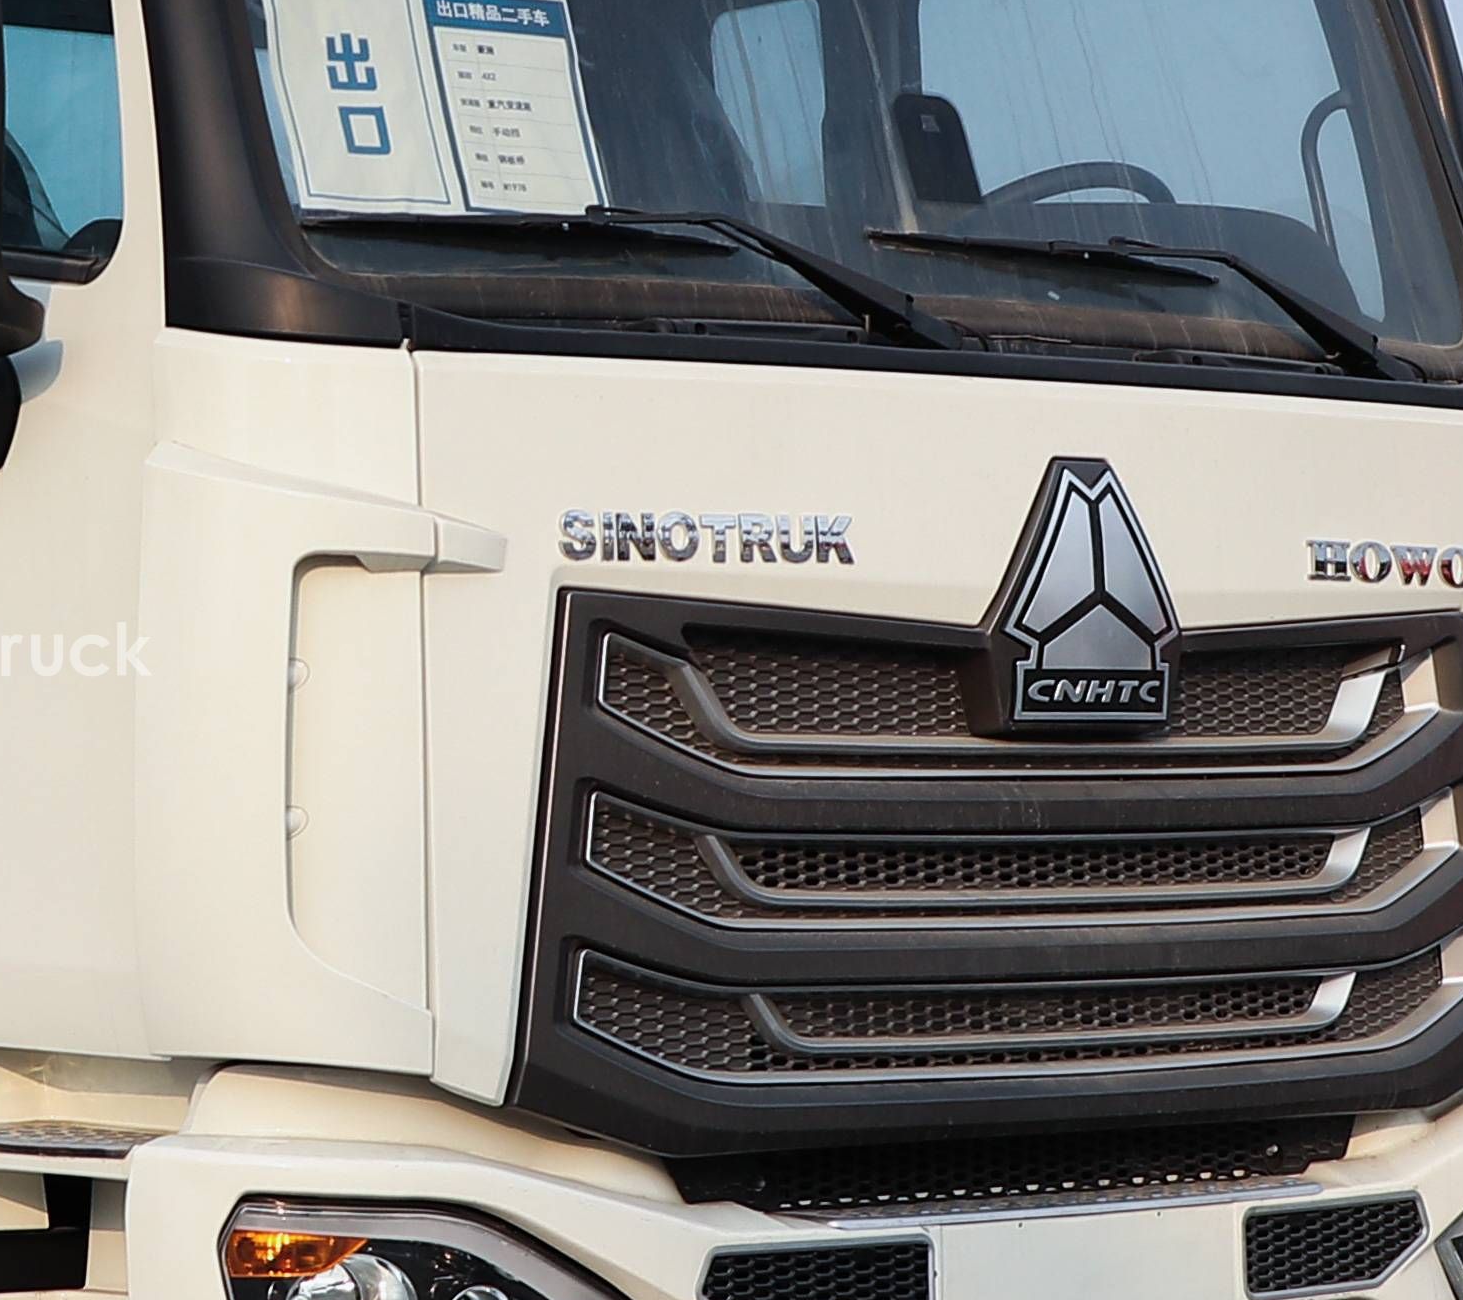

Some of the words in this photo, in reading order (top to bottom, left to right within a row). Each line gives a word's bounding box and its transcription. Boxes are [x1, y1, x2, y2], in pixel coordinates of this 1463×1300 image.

[436, 0, 550, 27] 出口精品二手车
[326, 33, 392, 155] 出口
[559, 510, 858, 566] SINOTRUK
[1025, 677, 1163, 706] CNHTC
